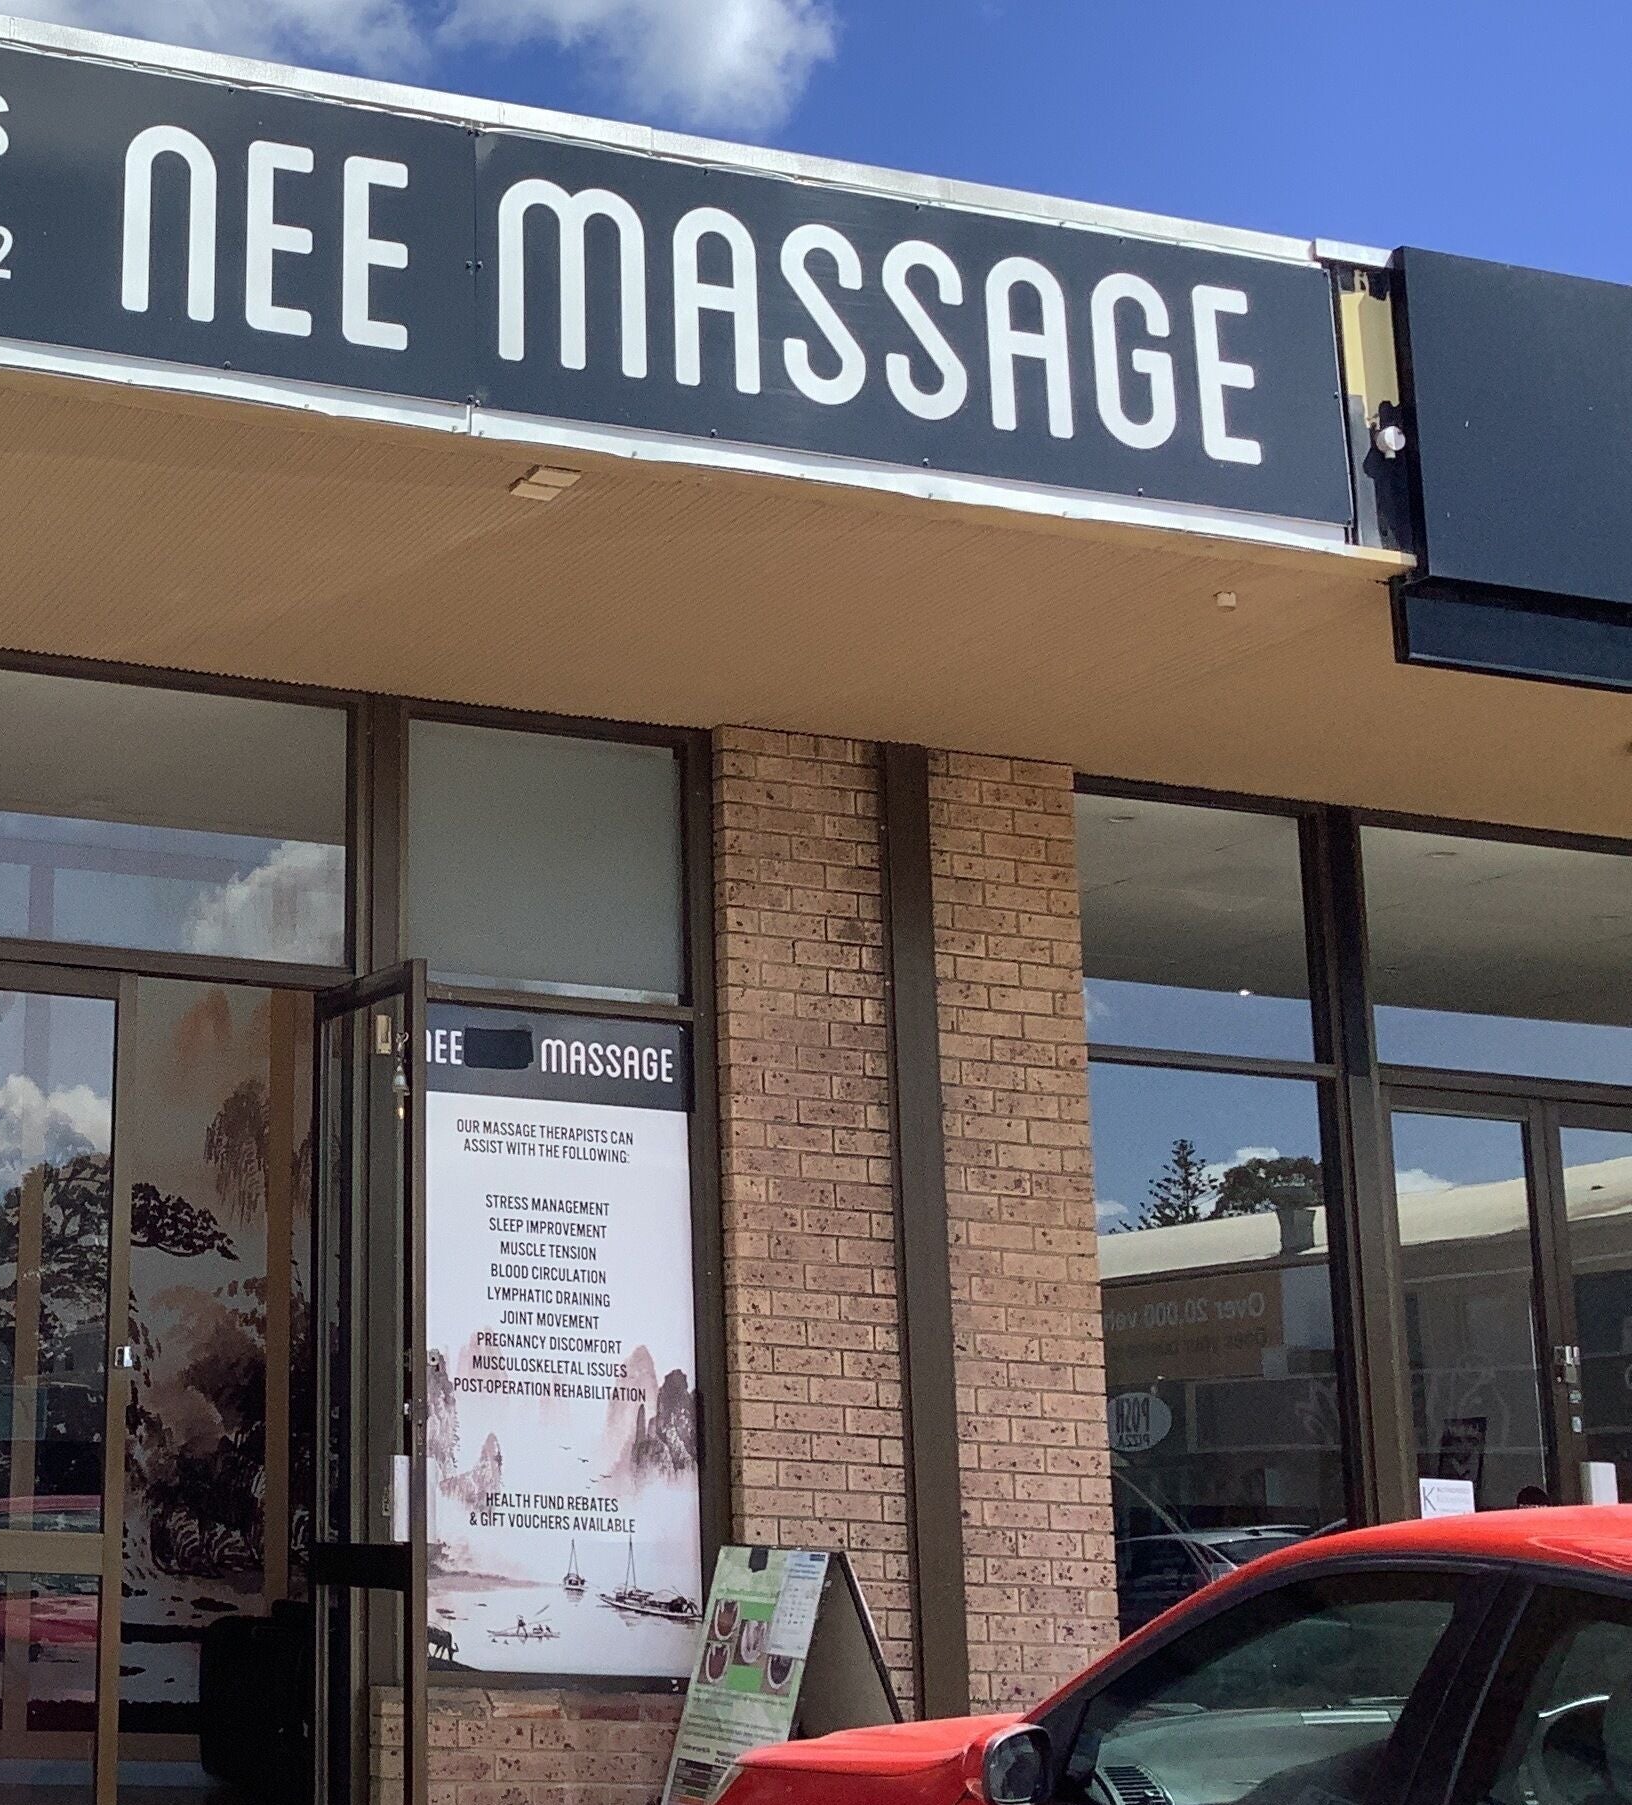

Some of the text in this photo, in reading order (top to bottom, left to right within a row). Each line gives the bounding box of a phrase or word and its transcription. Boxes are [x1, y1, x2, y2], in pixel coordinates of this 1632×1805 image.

[122, 124, 1264, 466] NEE MASSAGE
[541, 1039, 673, 1083] MASSAGE
[457, 1119, 634, 1145] OUR MASSAGE THERAPISTS CAN
[464, 1139, 630, 1164] ASSIST WITH THE FOLLOWING:
[486, 1194, 609, 1216] STRESS MANAGEMENT
[489, 1218, 607, 1239] SLEEP IMPROVEMENT
[501, 1241, 597, 1260] MUSCLE TENSION
[491, 1264, 606, 1284] BLOOD CIRCULATION
[488, 1287, 610, 1308] LYMPHATIC DRAINING
[500, 1311, 599, 1330] JOINT MOVEMENT
[477, 1332, 622, 1354] PREGNANCY DISCOMFORT
[472, 1356, 628, 1378] MUSCULOSKELETAL ISSUES
[454, 1378, 647, 1402] POST-OPERATION REHABILITATION
[486, 1493, 618, 1512] HEALTH FUND REBATES
[470, 1512, 635, 1533] & GIFT VOUCHERS AVAILABLE
